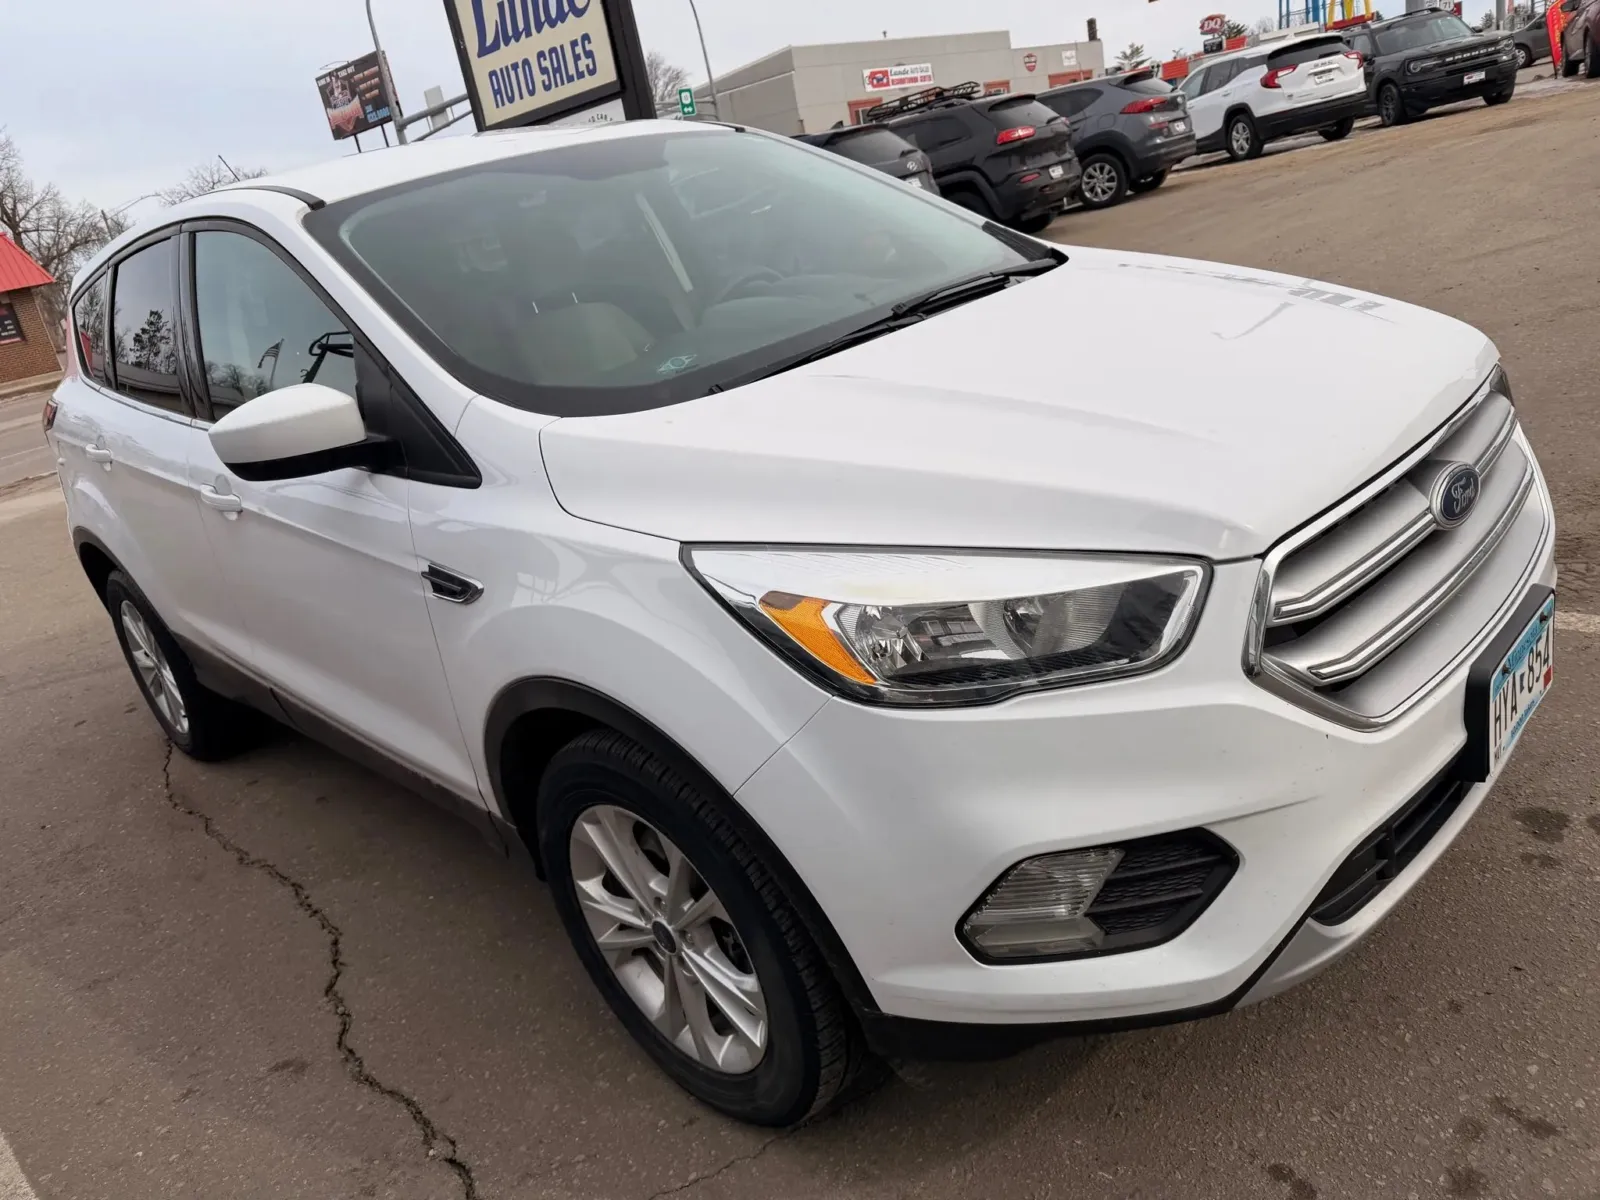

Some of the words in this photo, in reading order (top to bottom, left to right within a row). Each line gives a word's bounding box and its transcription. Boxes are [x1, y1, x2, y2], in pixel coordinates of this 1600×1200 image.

[1203, 17, 1222, 31] DQ
[488, 57, 536, 109] AUTO
[536, 32, 597, 92] SALES
[1451, 476, 1476, 514] Ford
[1494, 670, 1518, 748] HYA
[1527, 623, 1551, 694] 854
